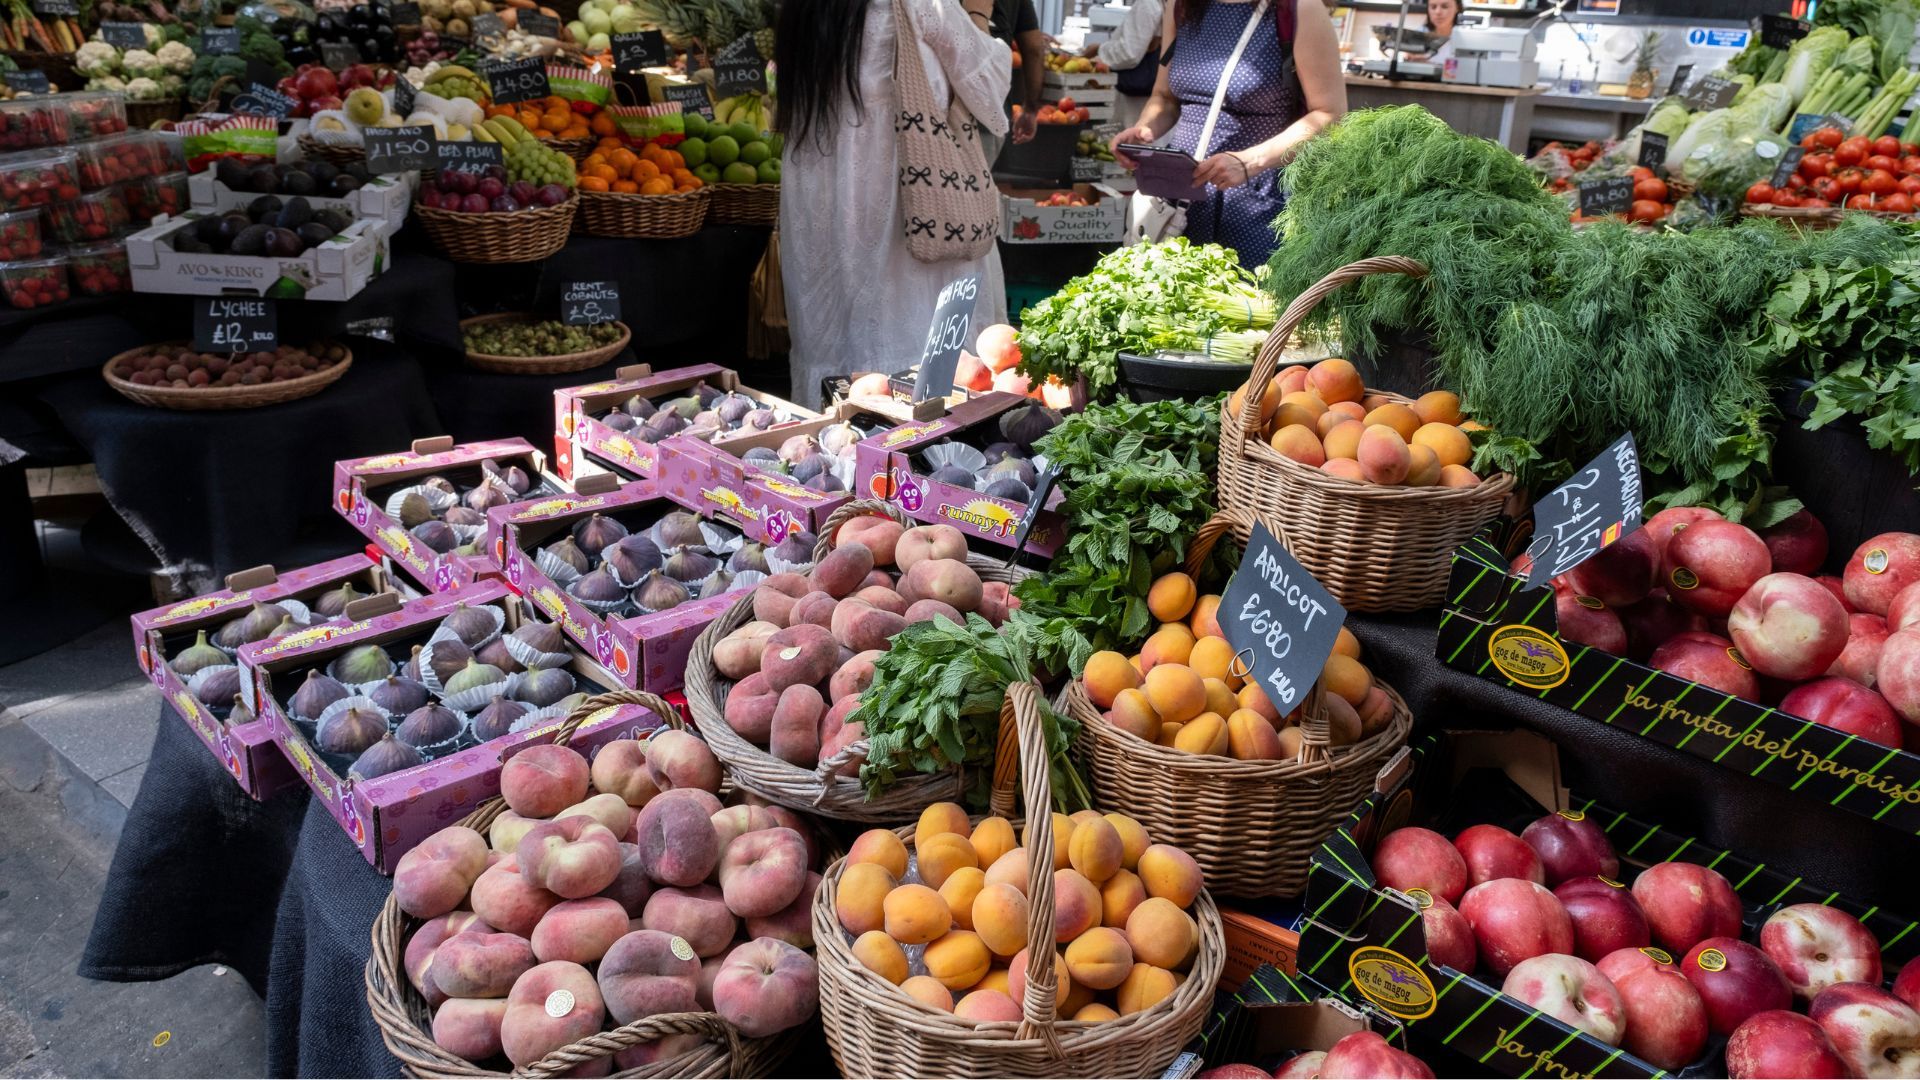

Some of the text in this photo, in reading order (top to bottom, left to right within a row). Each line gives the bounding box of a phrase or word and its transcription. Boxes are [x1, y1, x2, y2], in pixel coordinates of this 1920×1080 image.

[398, 127, 422, 136] AVO
[1053, 219, 1111, 230] Quality
[1062, 208, 1105, 218] Fresh
[1048, 231, 1115, 241] Produce
[177, 264, 208, 275] AVO
[224, 266, 264, 279] KING
[573, 282, 605, 292] KENT
[951, 277, 977, 301] FIGS
[209, 300, 266, 319] LYCHEE
[569, 301, 602, 321] £8
[212, 322, 244, 344] £12
[1552, 468, 1600, 506] 2
[939, 503, 1000, 533] sunny
[1253, 544, 1327, 633] APRICOT
[1494, 646, 1509, 661] gog
[1510, 650, 1520, 662] de
[1521, 655, 1546, 673] magog
[1267, 667, 1296, 704] KILO
[1624, 684, 1920, 804] la fruta del paraíso
[1355, 967, 1371, 984] gog
[1372, 972, 1382, 986] de
[1384, 980, 1411, 1003] magog
[1496, 1027, 1533, 1058] la
